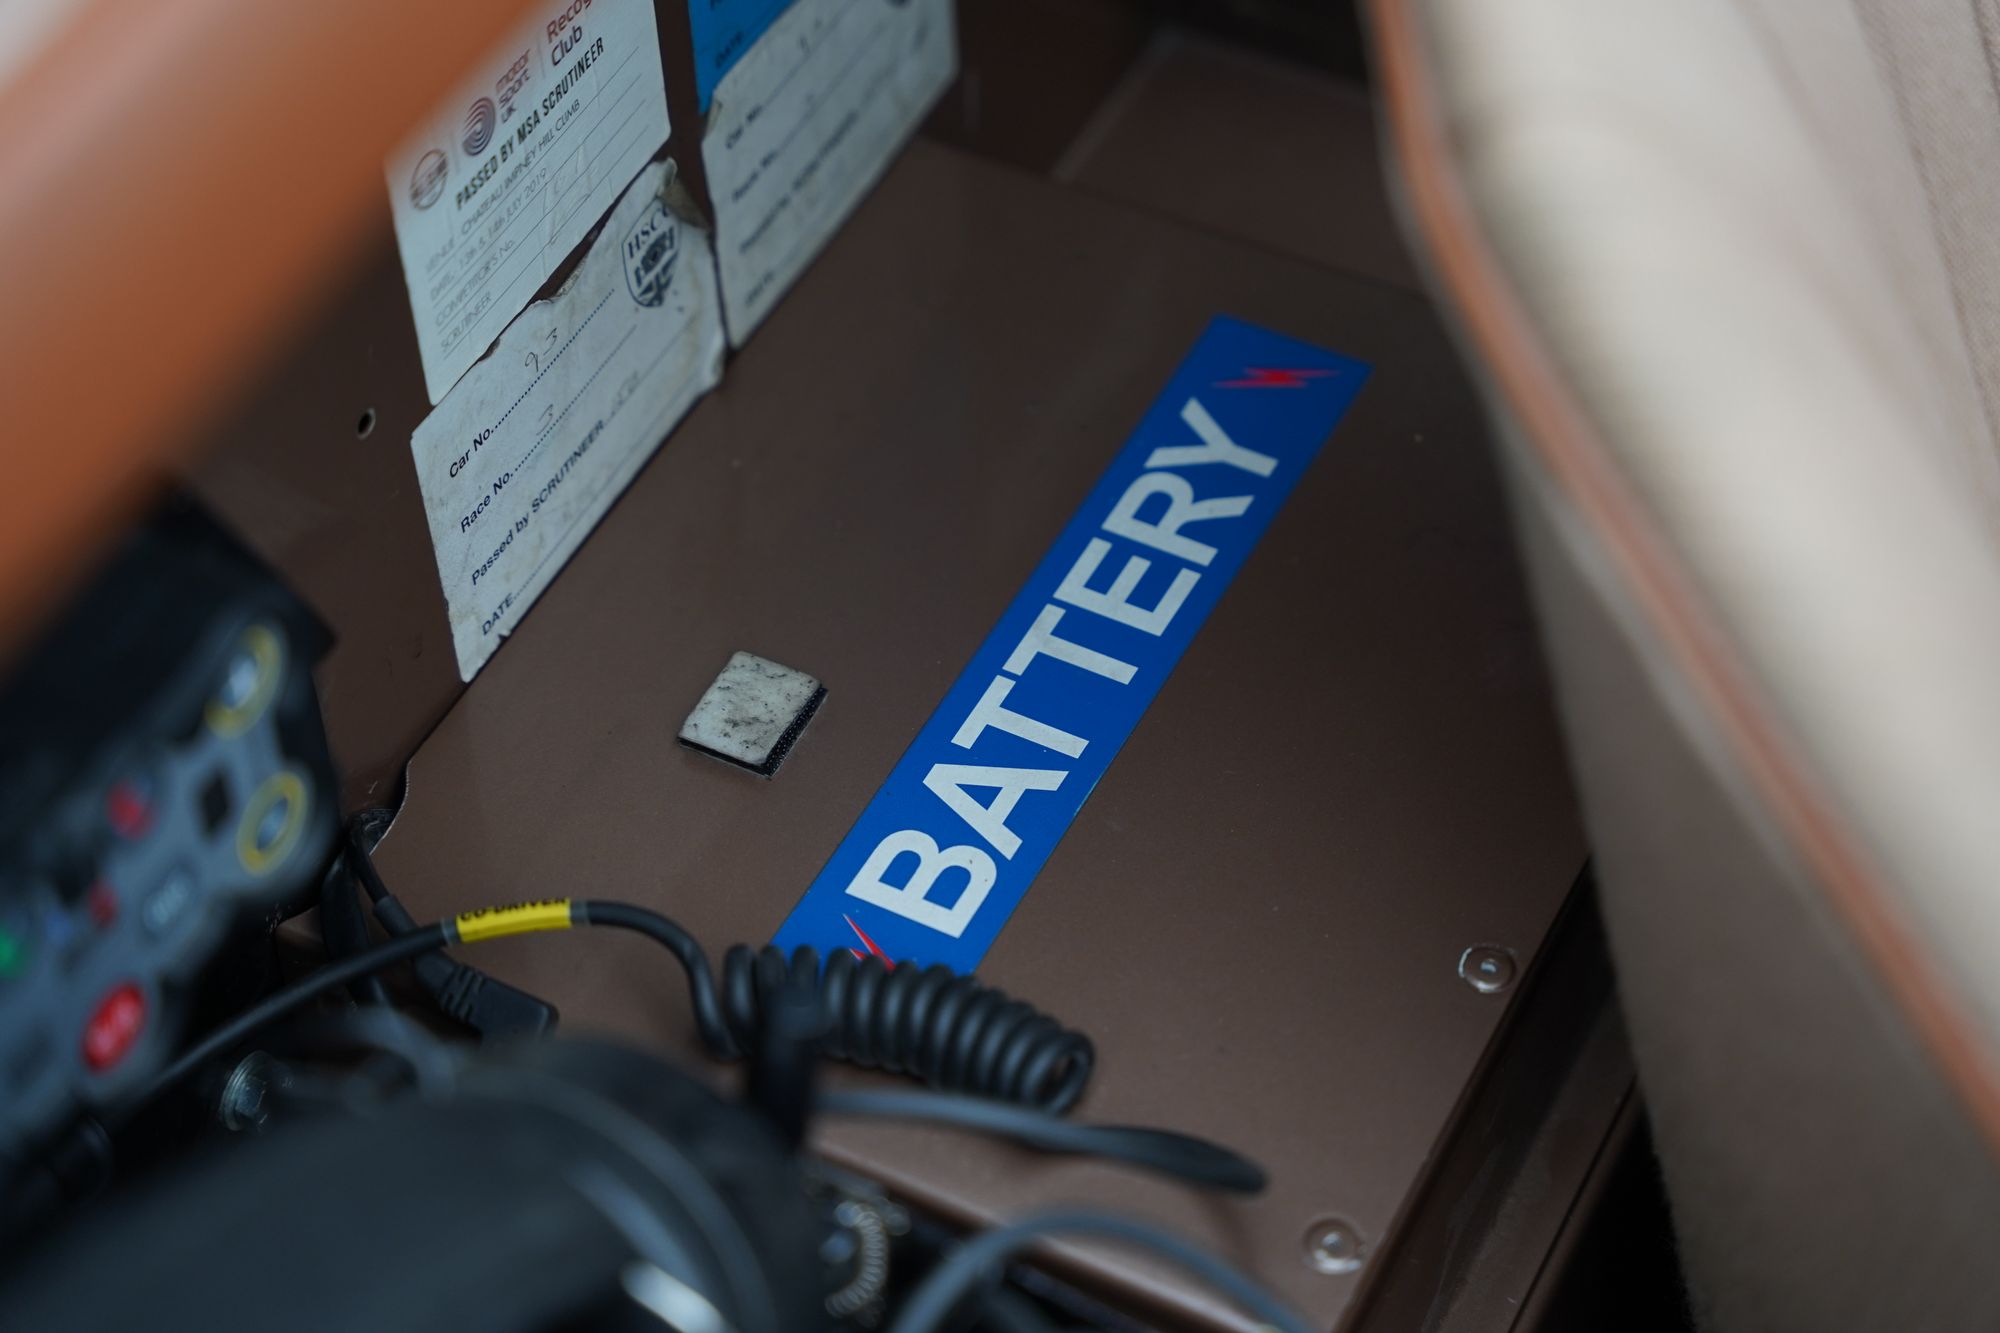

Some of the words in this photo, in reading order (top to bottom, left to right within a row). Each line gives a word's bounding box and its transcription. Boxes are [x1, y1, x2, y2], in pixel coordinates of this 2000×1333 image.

[550, 24, 583, 67] Club
[499, 68, 531, 109] sport
[455, 154, 499, 211] PASSED
[499, 137, 516, 165] BY
[516, 109, 541, 147] MSA
[541, 37, 605, 118] SCRUTINEER
[501, 104, 518, 124] UK
[461, 184, 504, 236] CHATEAU
[537, 126, 557, 154] HILL
[555, 98, 582, 134] CLIMB
[505, 194, 524, 224] JULY
[523, 166, 548, 196] 2019
[440, 290, 493, 352] SCRUTINEER
[524, 326, 558, 373] 93
[448, 450, 472, 480] Car
[460, 492, 491, 534] Race
[470, 529, 515, 586] Passed
[515, 511, 532, 540] by
[531, 418, 605, 514] SCRUTINEER
[481, 591, 515, 637] DATE
[844, 397, 1279, 939] BATTERY
